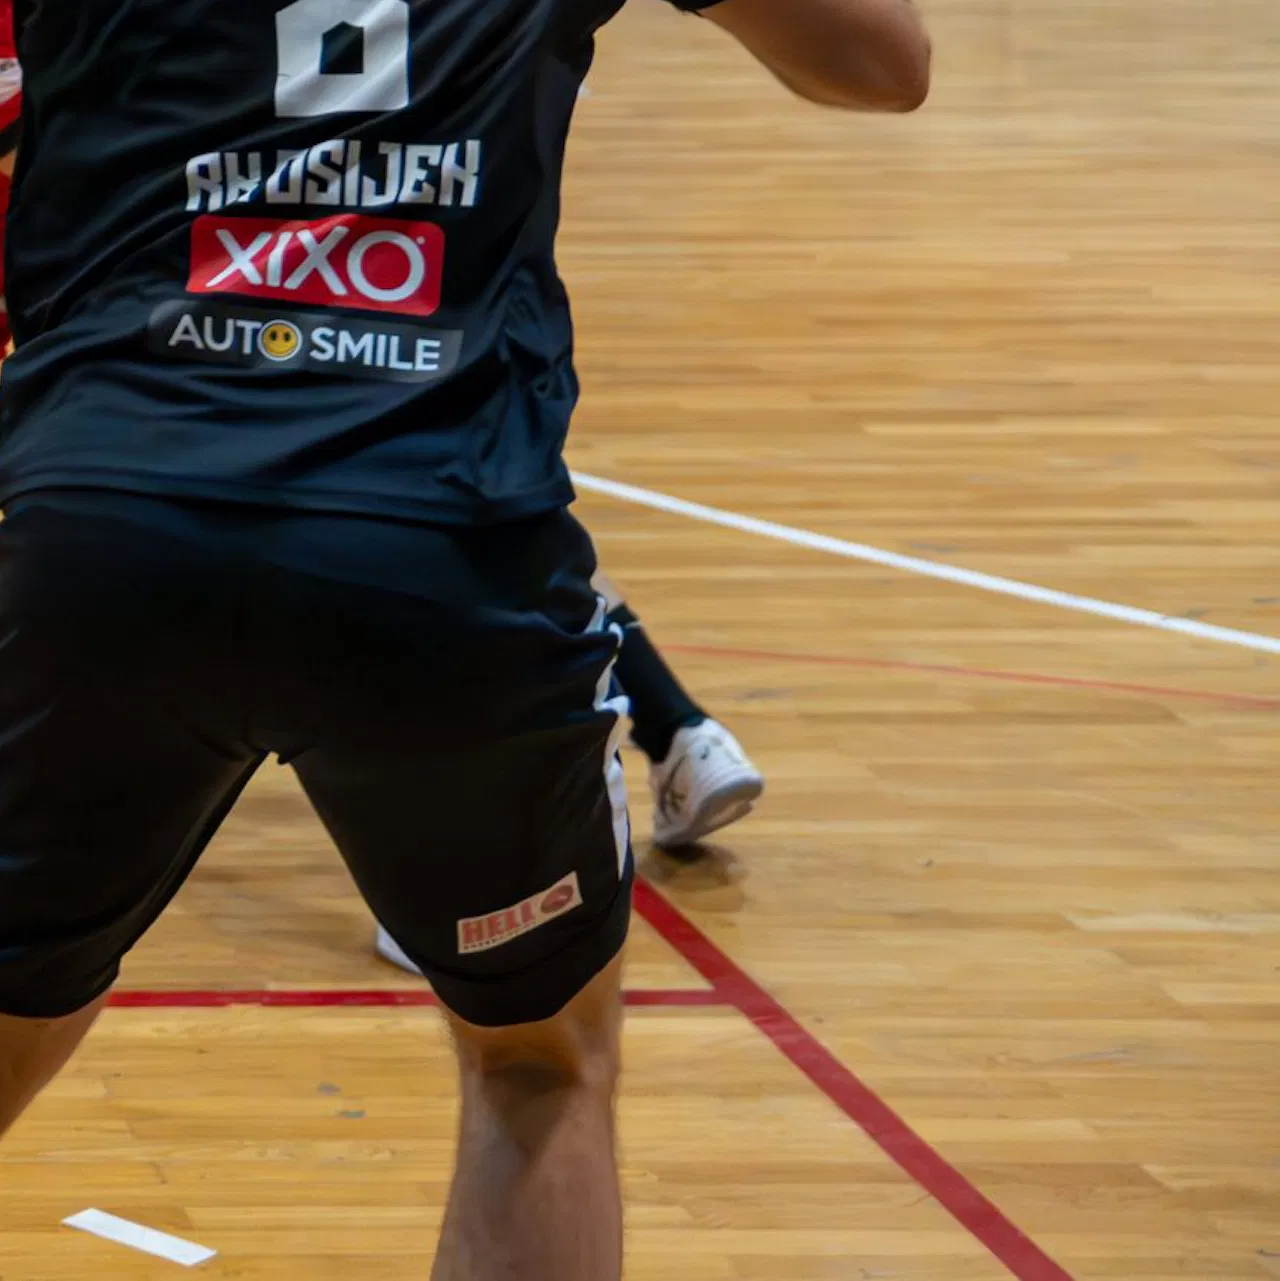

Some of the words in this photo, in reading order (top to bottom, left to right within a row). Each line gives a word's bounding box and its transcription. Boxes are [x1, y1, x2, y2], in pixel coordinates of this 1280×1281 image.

[266, 139, 482, 208] OSIJEK
[205, 225, 427, 302] XIXO
[309, 326, 441, 371] SMILE
